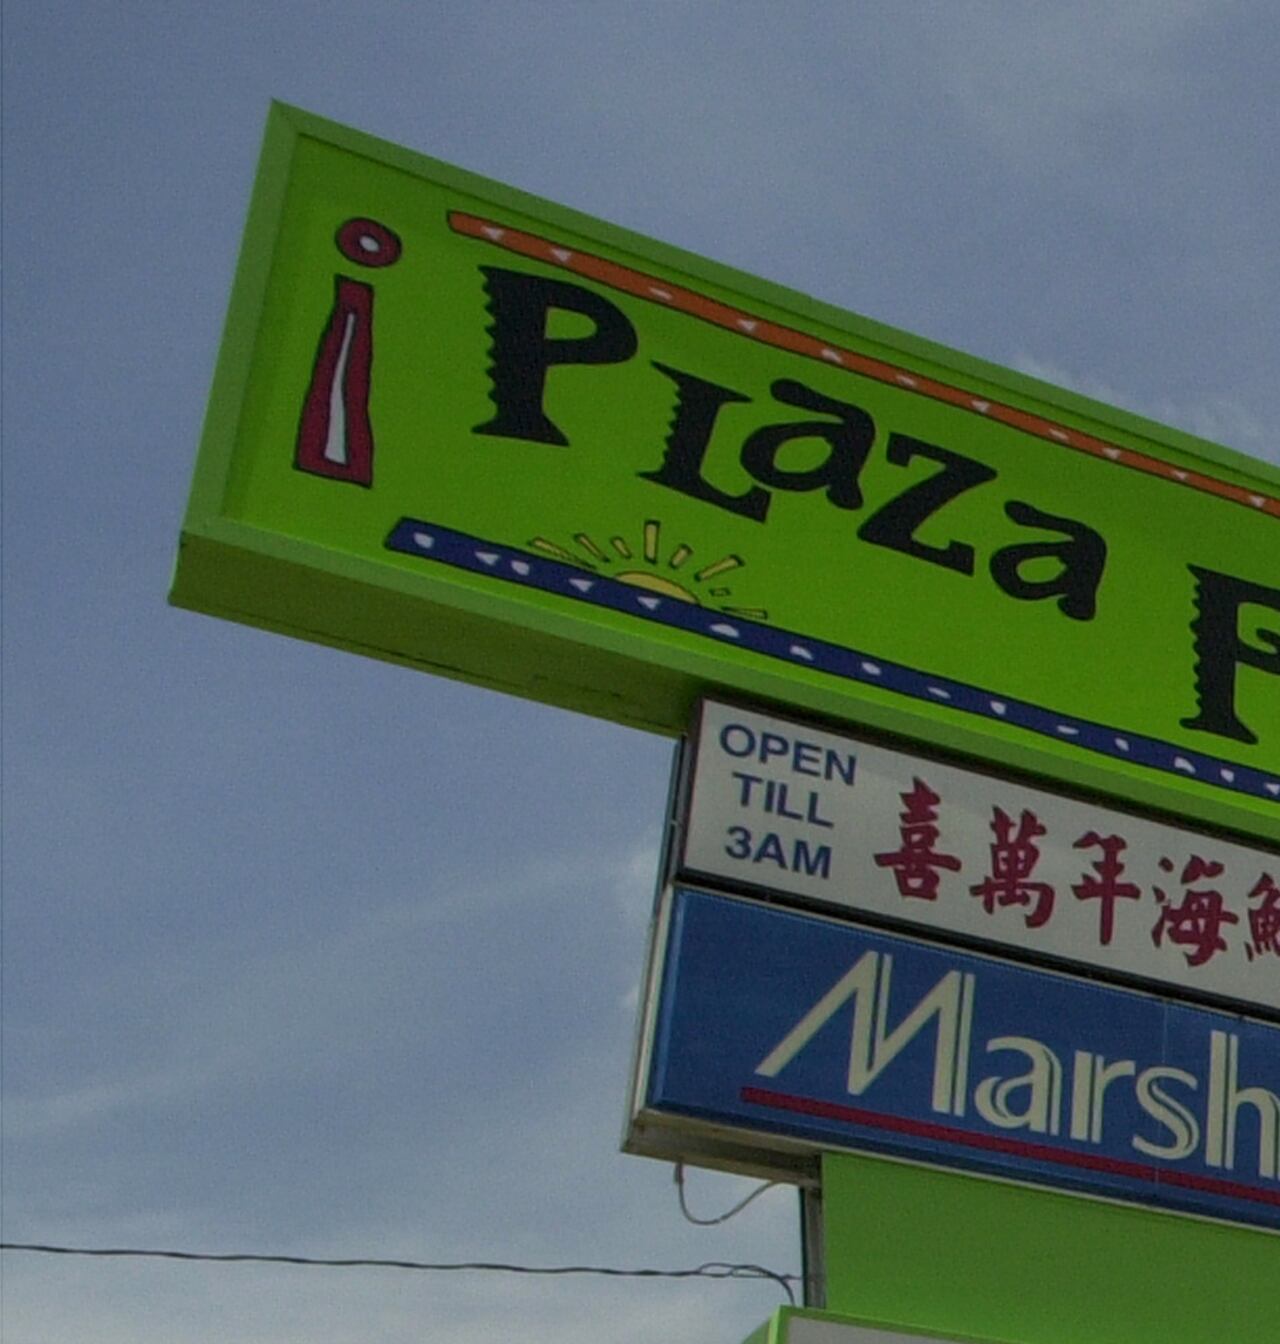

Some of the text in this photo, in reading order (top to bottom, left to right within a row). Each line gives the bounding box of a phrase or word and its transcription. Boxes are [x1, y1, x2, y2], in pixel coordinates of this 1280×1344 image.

[719, 723, 857, 787] OPEN
[731, 771, 835, 829] TILL
[724, 825, 833, 880] 3AM
